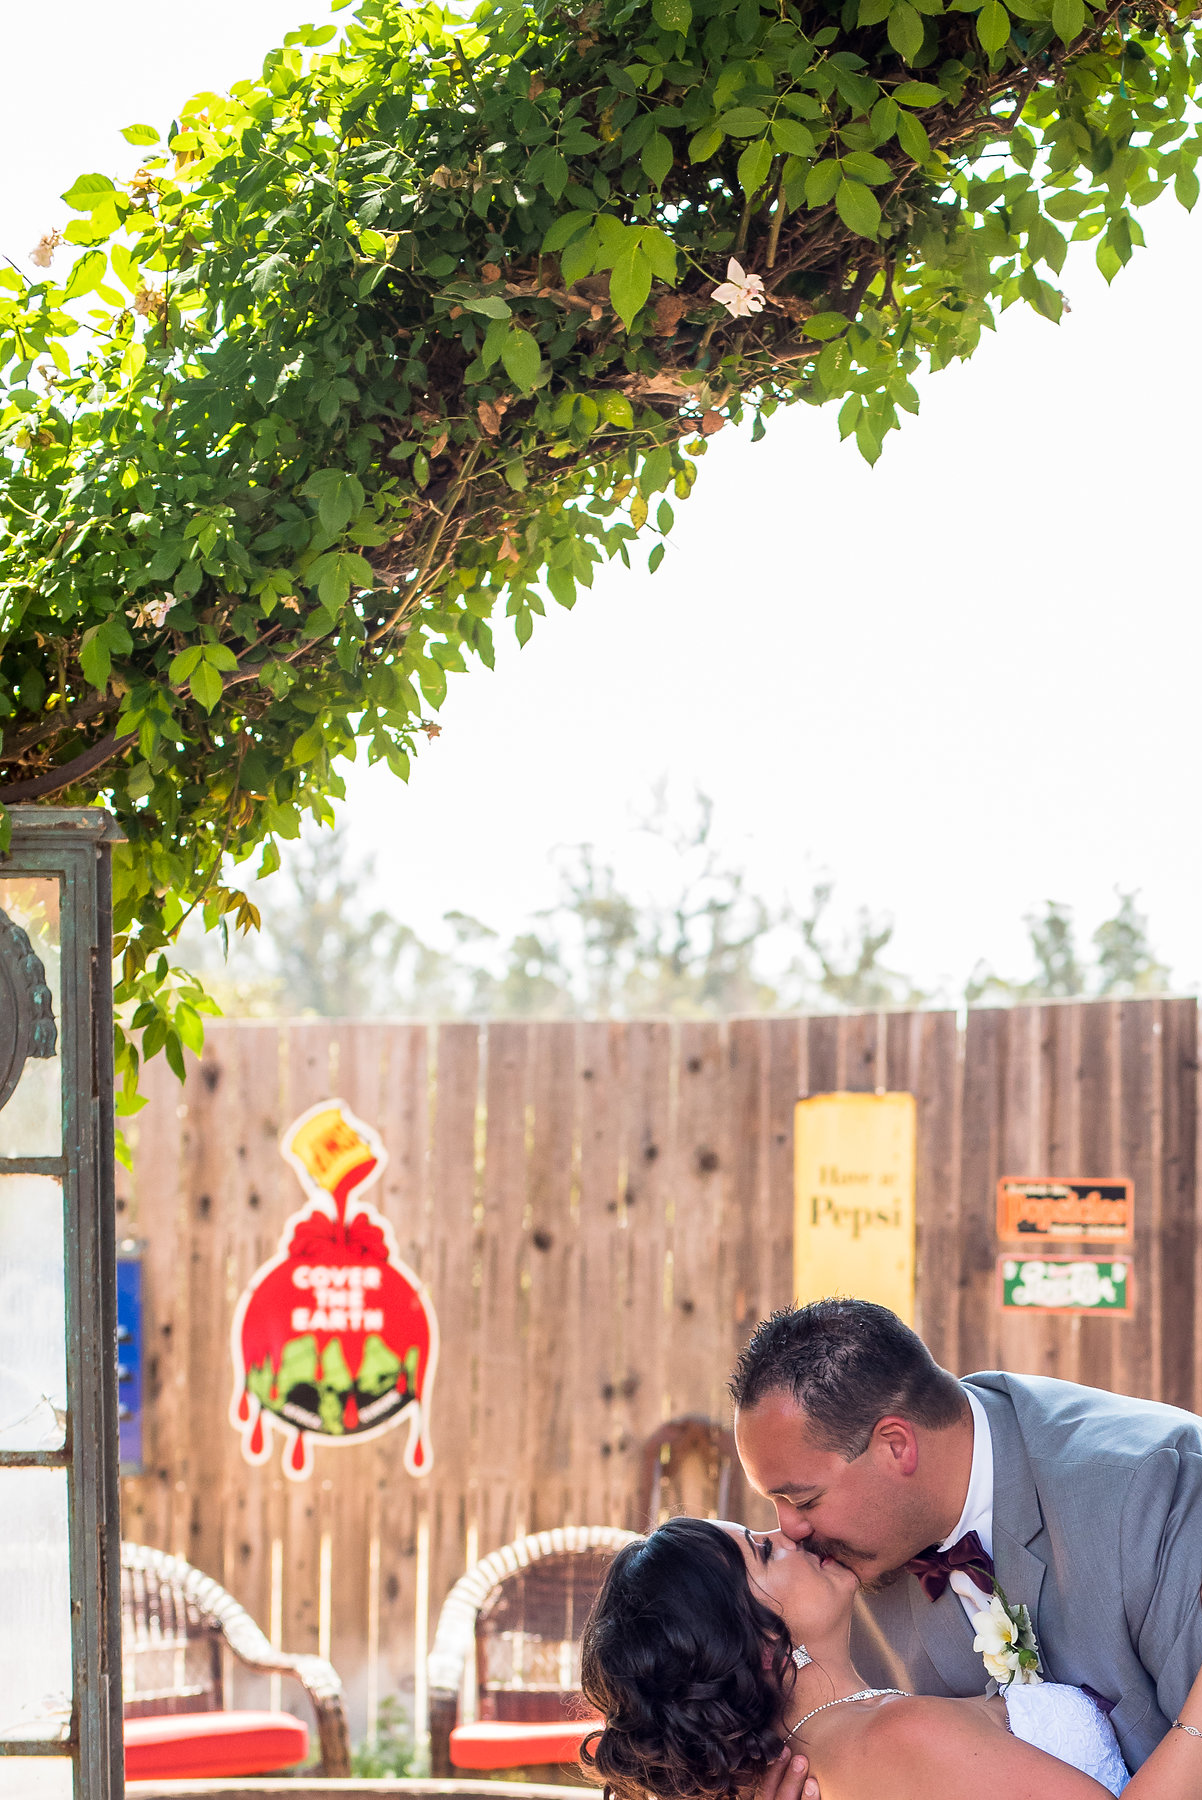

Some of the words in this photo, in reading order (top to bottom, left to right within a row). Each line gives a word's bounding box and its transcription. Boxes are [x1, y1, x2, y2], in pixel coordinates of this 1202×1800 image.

[809, 1195, 901, 1242] Pepsi
[292, 1266, 382, 1290] COVER
[313, 1288, 365, 1310] THE
[292, 1308, 384, 1332] EARTH
